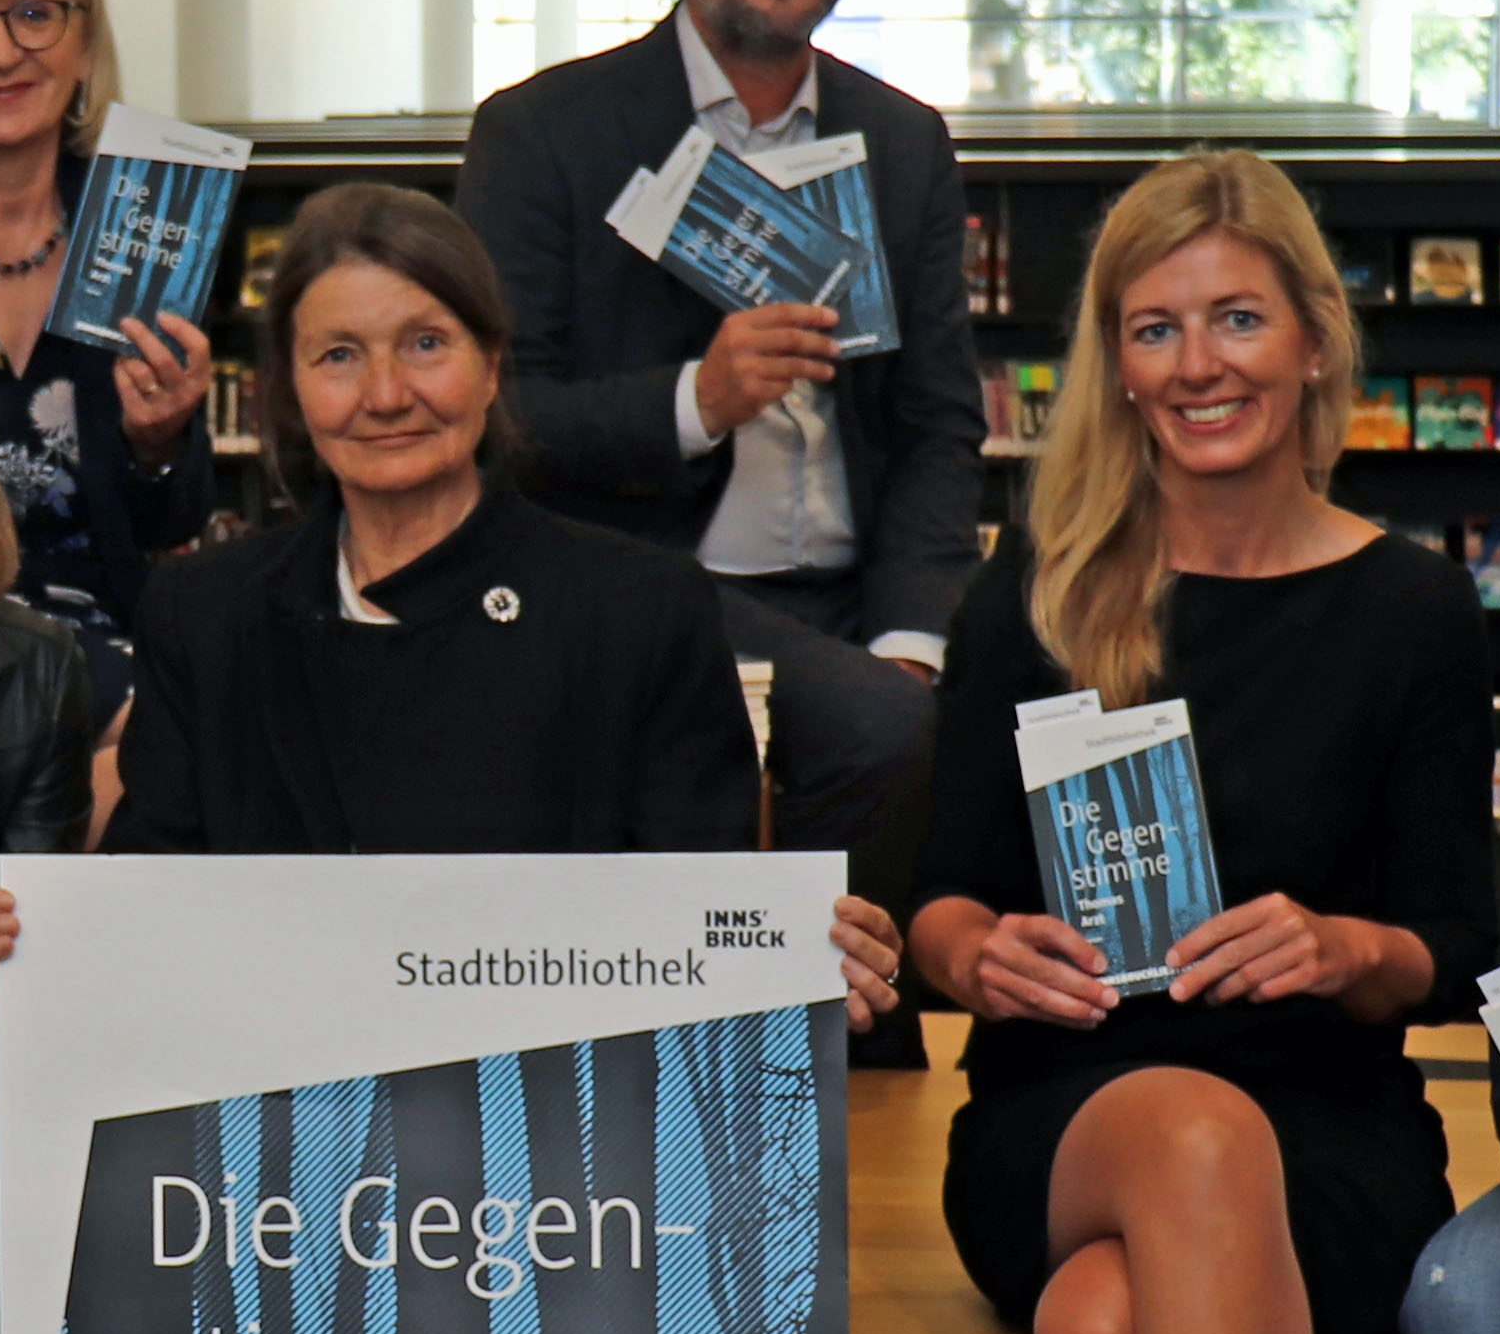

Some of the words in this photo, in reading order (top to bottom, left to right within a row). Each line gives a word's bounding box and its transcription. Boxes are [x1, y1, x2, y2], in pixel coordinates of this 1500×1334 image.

[115, 176, 149, 204] Die
[1059, 799, 1100, 827] Die
[1086, 820, 1178, 856] Gegen-
[1071, 853, 1171, 891] stimme
[705, 930, 786, 948] BRUCK
[396, 948, 706, 987] Stadtbibliothek
[151, 1173, 302, 1269] Die
[340, 1176, 696, 1300] Gegen-
